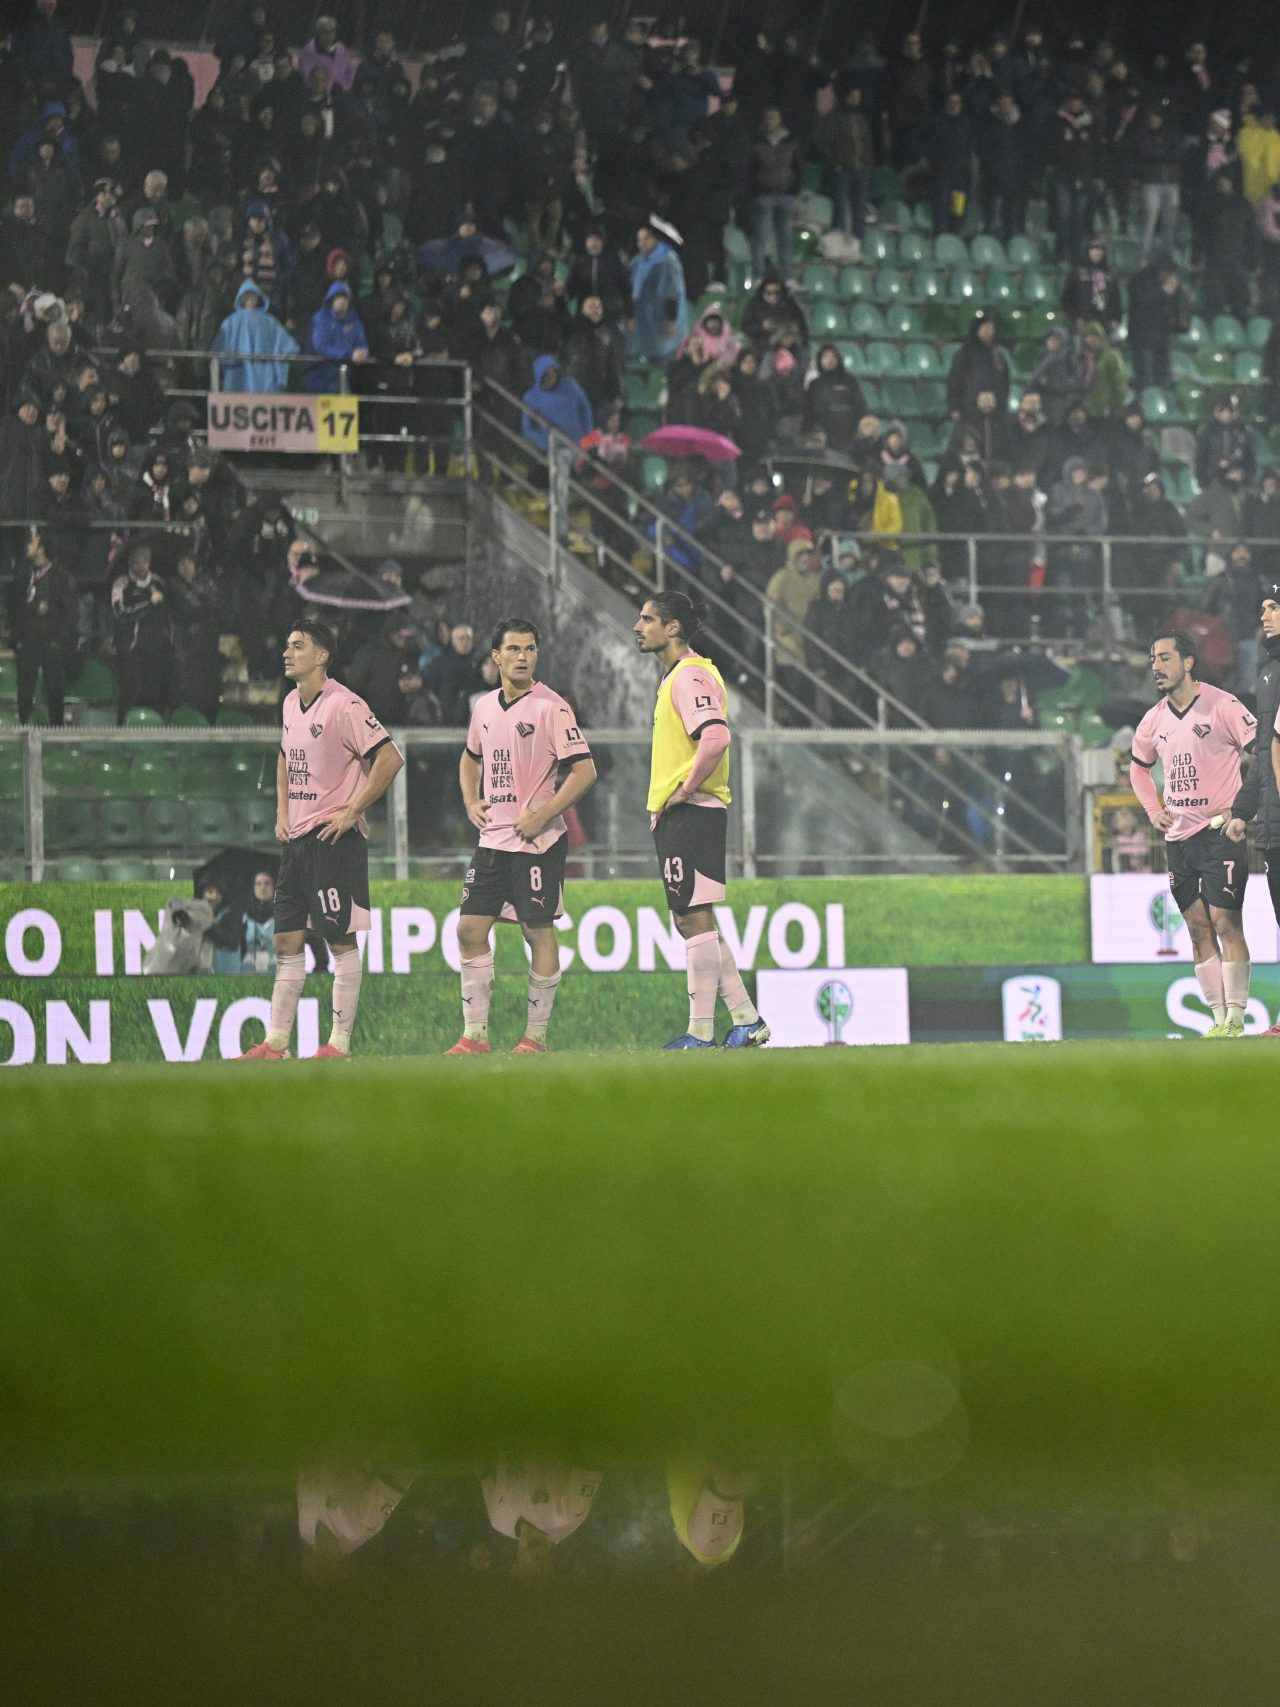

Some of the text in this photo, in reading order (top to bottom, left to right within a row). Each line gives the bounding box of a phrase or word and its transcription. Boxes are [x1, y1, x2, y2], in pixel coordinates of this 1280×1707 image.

[211, 404, 314, 433] USCITA
[323, 412, 355, 437] 17
[288, 761, 308, 774] WILD
[290, 749, 306, 761] OLD
[1173, 753, 1192, 767] OLD
[1170, 765, 1197, 780] WILD
[1170, 778, 1199, 792] WEST
[529, 866, 543, 892] 8
[664, 856, 684, 883] 43
[1223, 861, 1235, 885] 7
[317, 887, 341, 913] 18
[5, 908, 62, 976] O
[713, 902, 846, 969] VOI
[147, 998, 320, 1062] VOI
